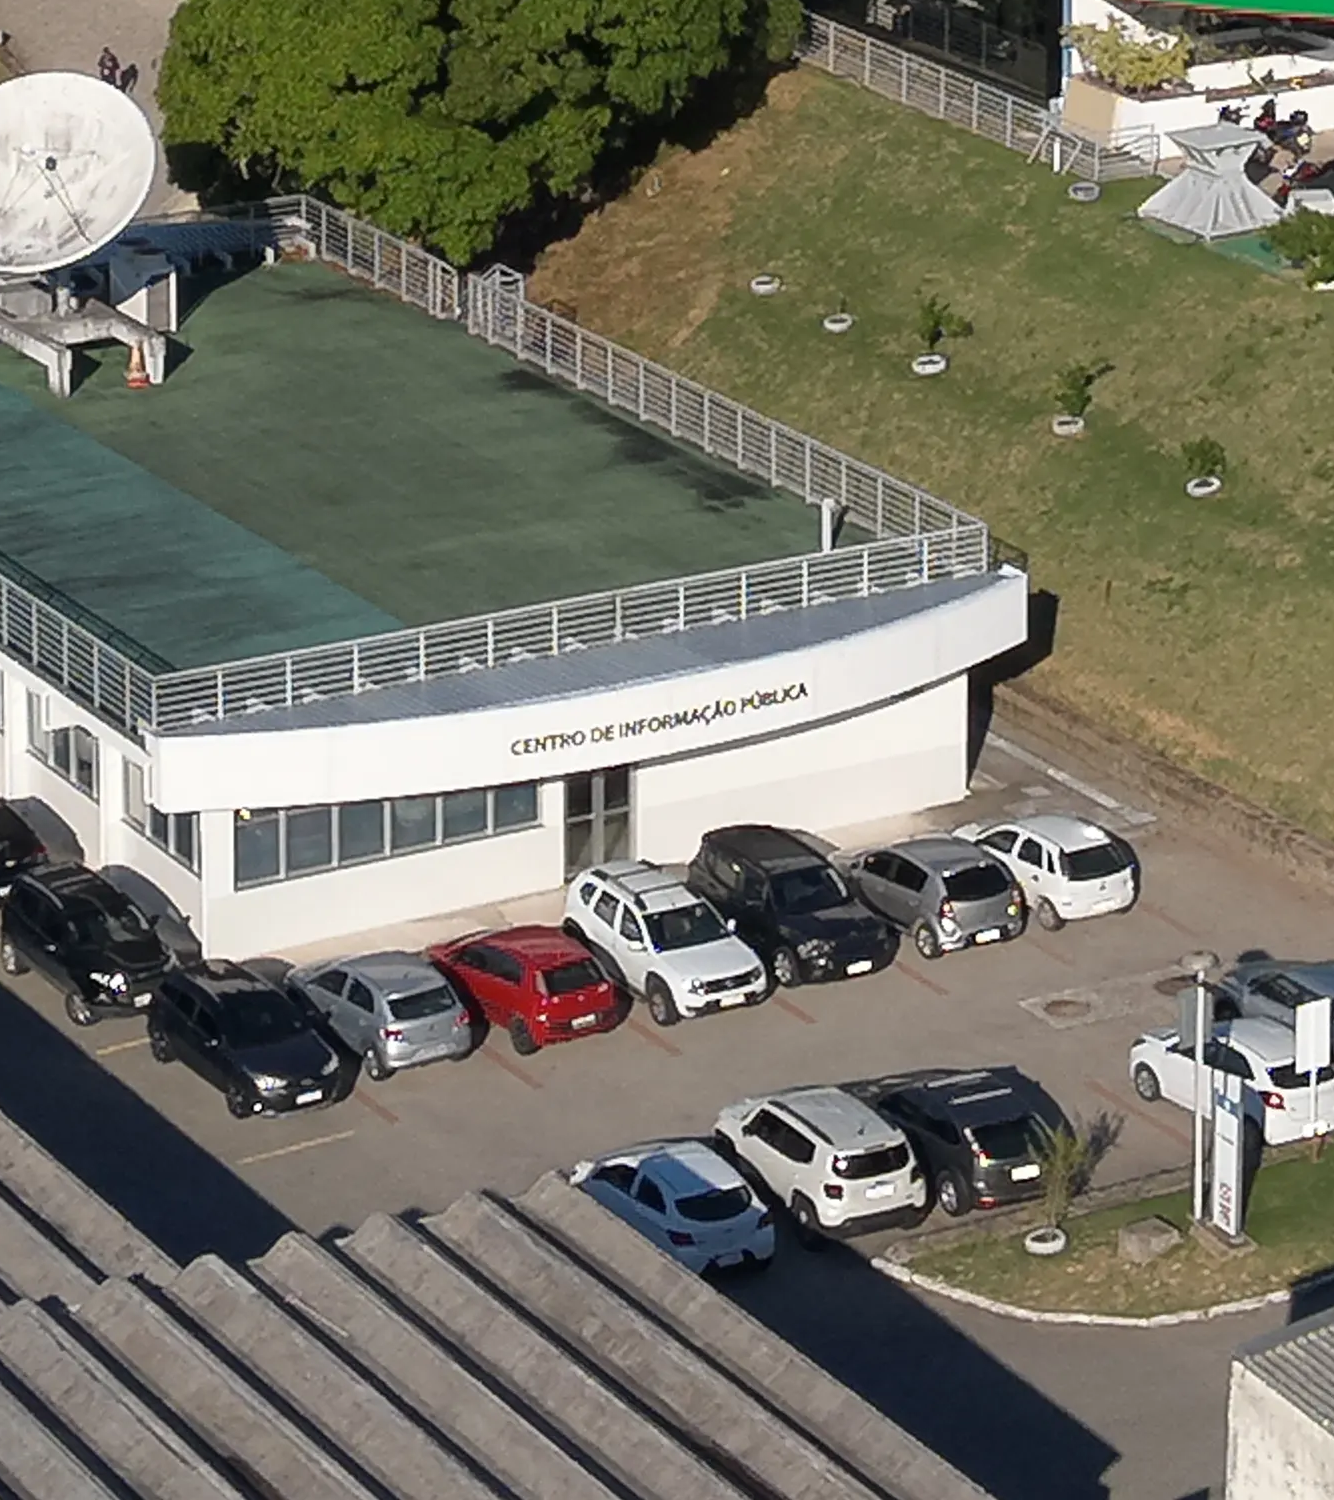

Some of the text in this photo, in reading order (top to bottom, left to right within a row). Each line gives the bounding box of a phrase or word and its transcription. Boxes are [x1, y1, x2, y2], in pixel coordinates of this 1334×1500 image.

[511, 682, 808, 756] CENTRO DE INFORMAÇÃO PÚBLICA
